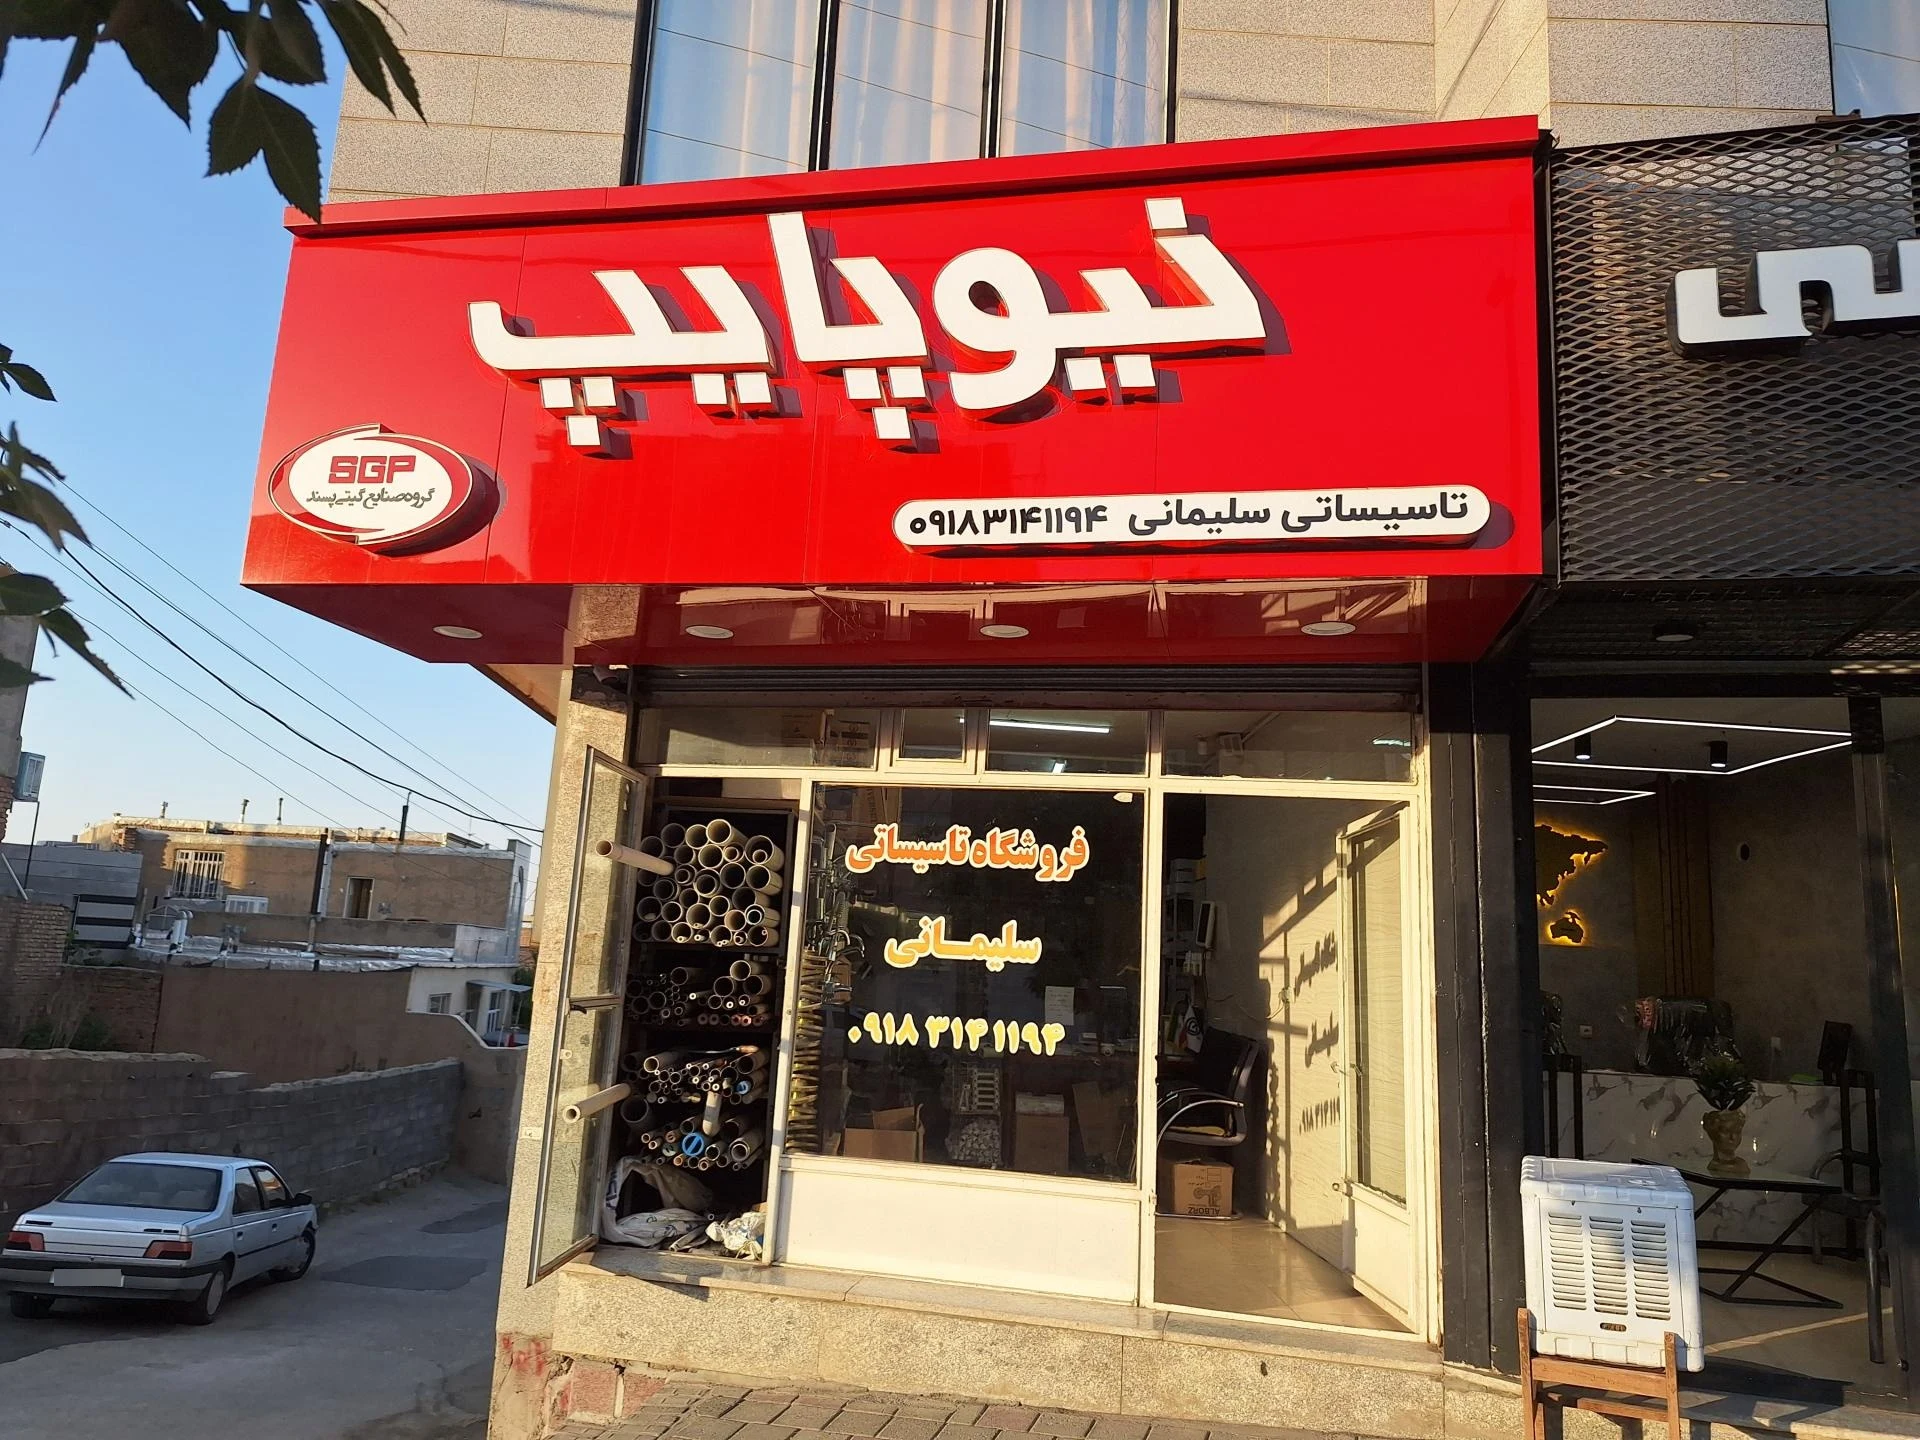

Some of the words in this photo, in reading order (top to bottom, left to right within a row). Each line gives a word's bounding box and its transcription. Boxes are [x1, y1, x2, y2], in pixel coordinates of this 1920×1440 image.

[328, 455, 417, 484] SGP
[306, 490, 337, 509] پسند
[335, 487, 367, 507] گیتی
[362, 487, 405, 510] صنایع
[403, 487, 436, 509] گروه
[1281, 491, 1469, 533] تاسیساتی
[909, 504, 1108, 537] ۰۹۱۸۳۱۴۱۱۹۴
[1128, 498, 1271, 537] سلیمانی
[845, 822, 971, 874] تاسیساتی
[968, 825, 1090, 882] فروشگاه
[884, 915, 1042, 972] سلیمانی
